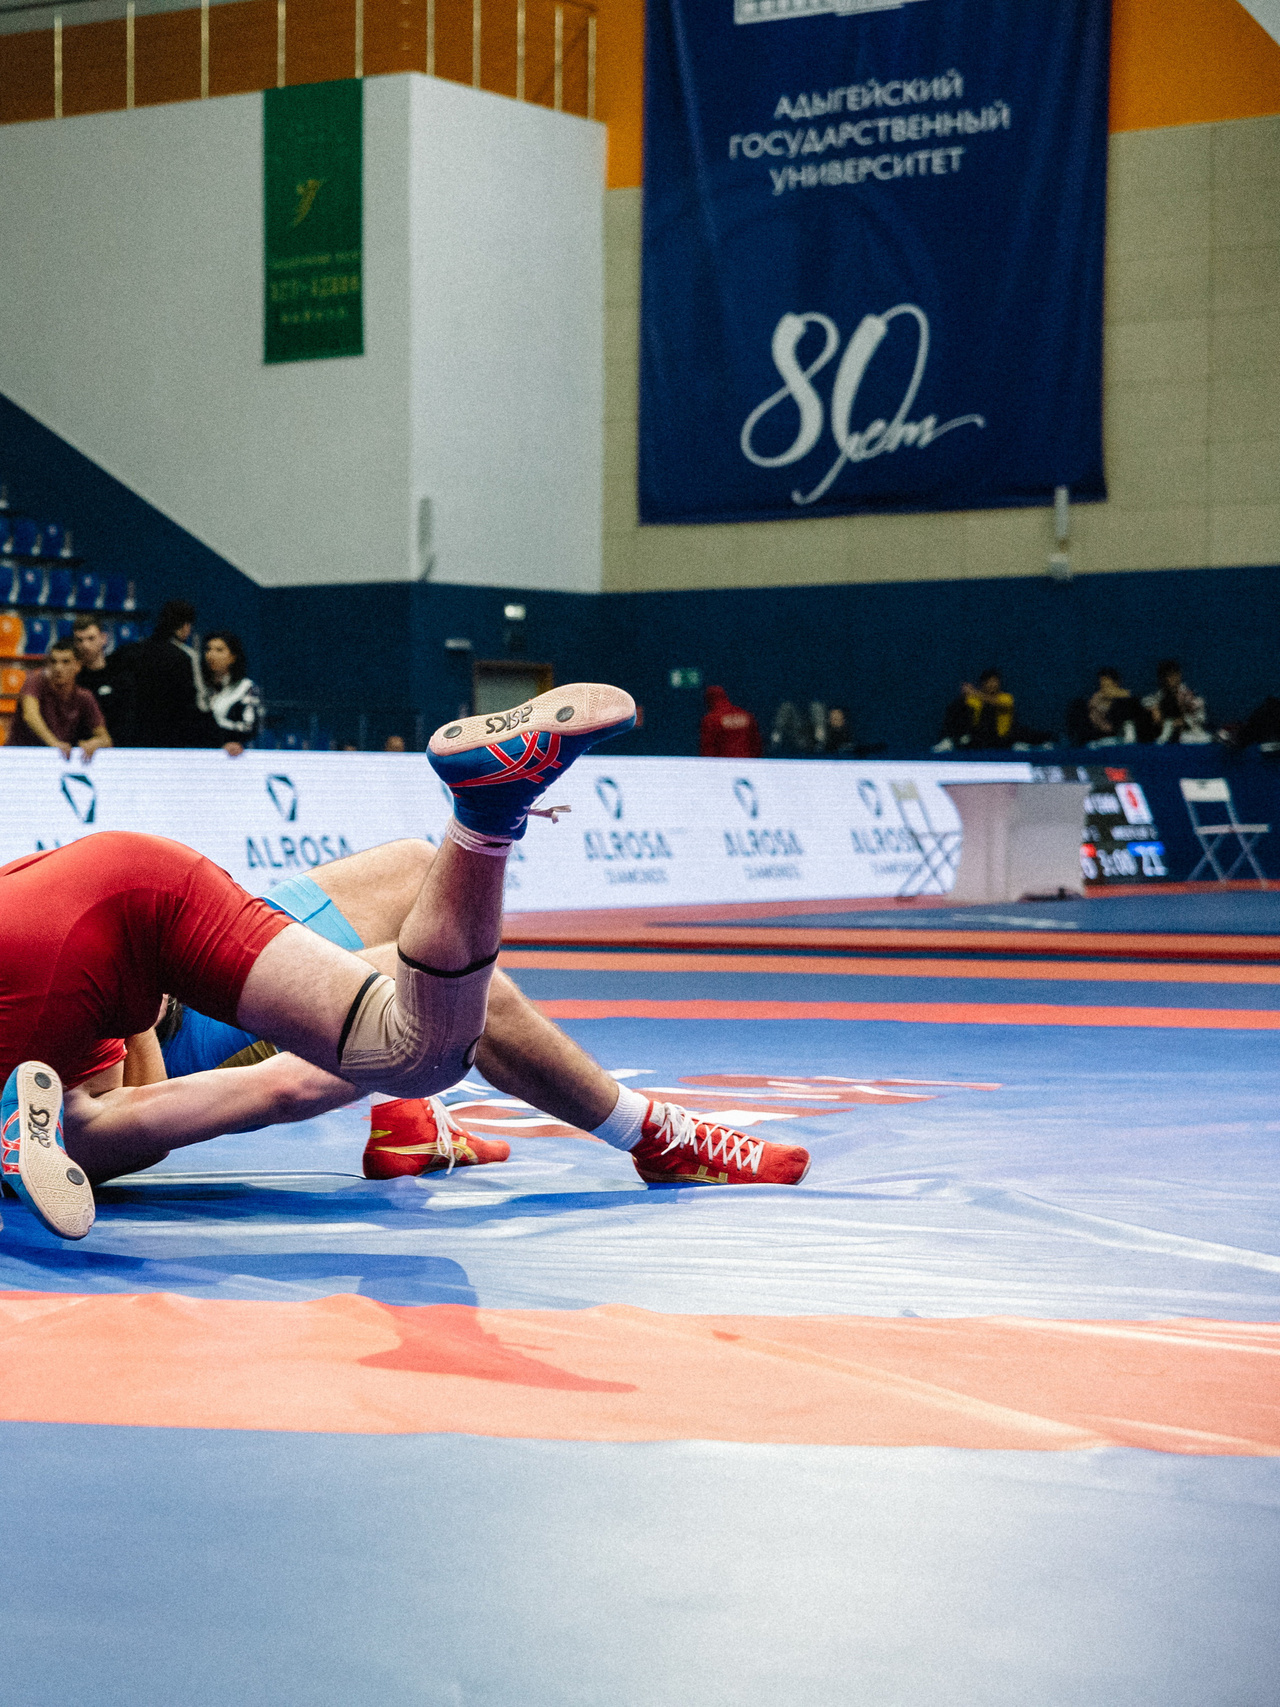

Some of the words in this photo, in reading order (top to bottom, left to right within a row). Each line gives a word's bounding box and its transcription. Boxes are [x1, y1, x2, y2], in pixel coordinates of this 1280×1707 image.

[773, 68, 964, 121] АДЫГЕЙСКИЙ
[729, 100, 1012, 160] ГОСУДАРСТВЕННЫЙ
[769, 146, 966, 195] УНИВЕРСИТЕТ
[741, 303, 930, 468] 80
